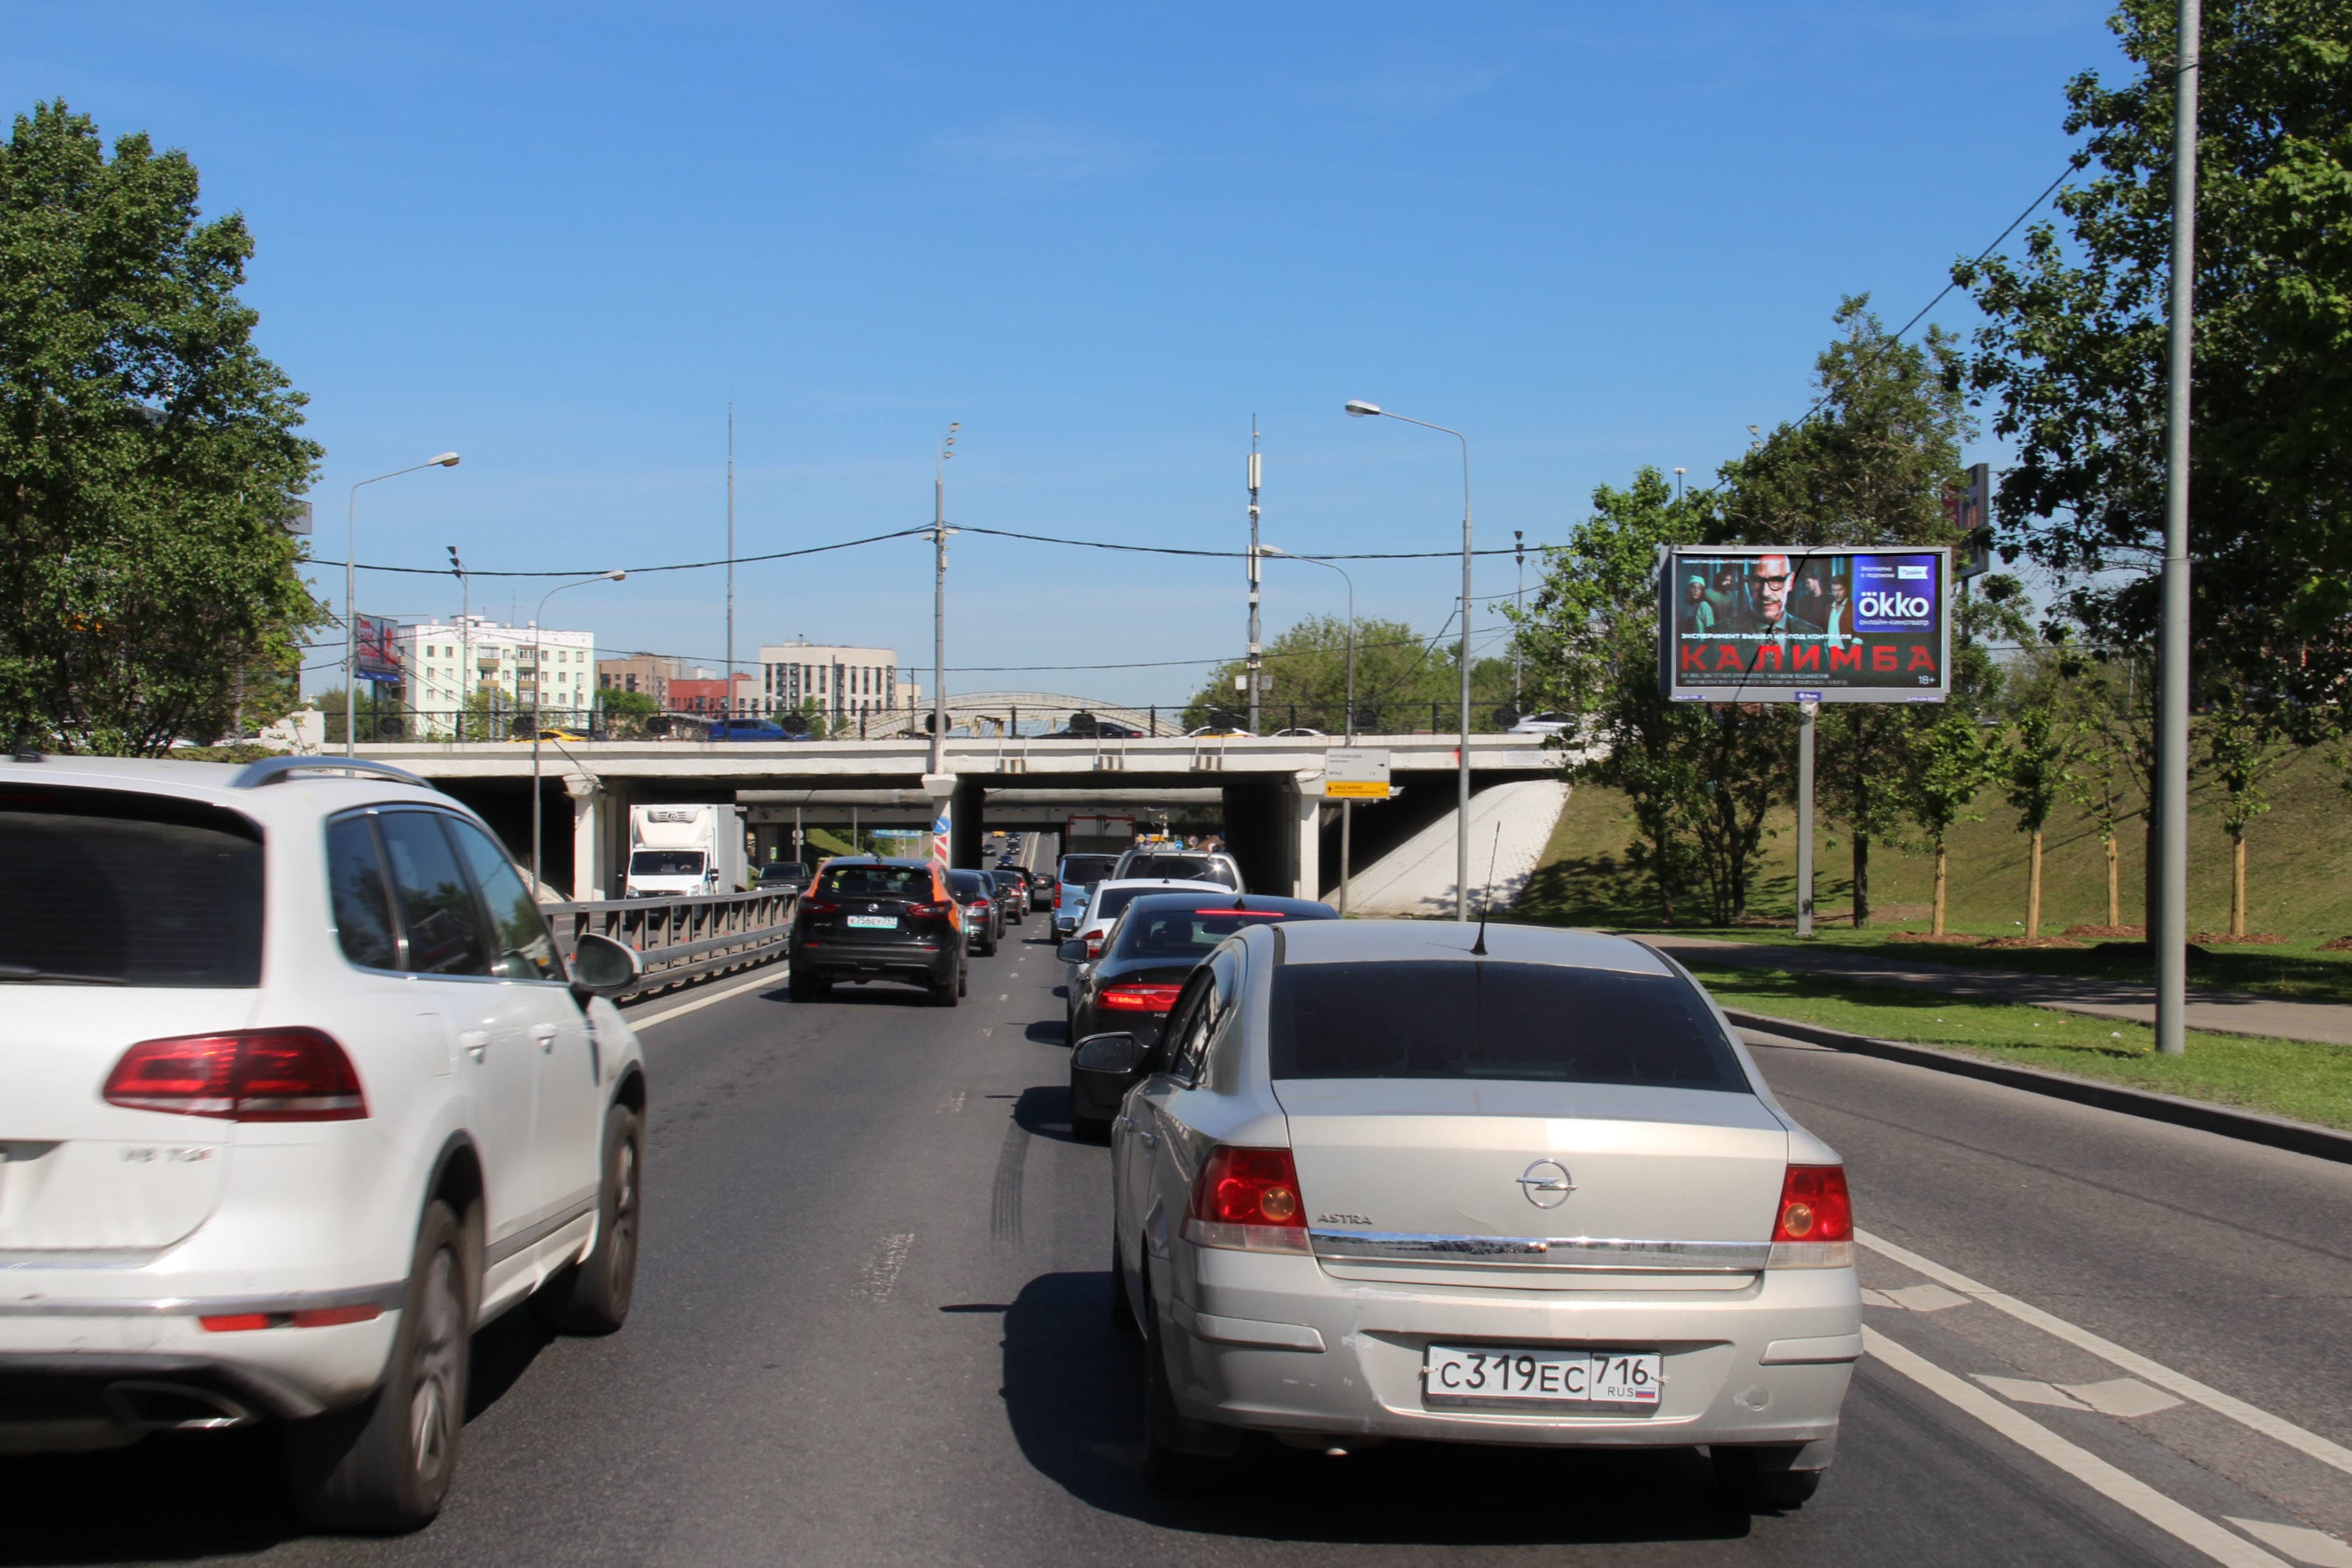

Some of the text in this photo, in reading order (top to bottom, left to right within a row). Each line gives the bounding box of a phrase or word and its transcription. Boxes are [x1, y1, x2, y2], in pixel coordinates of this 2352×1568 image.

[1681, 644, 1937, 671] КАЛИМБА
[1918, 675, 1936, 685] 18+
[1317, 1213, 1374, 1225] ASTRA
[1594, 1357, 1649, 1385] 716
[1607, 1386, 1635, 1397] RUS
